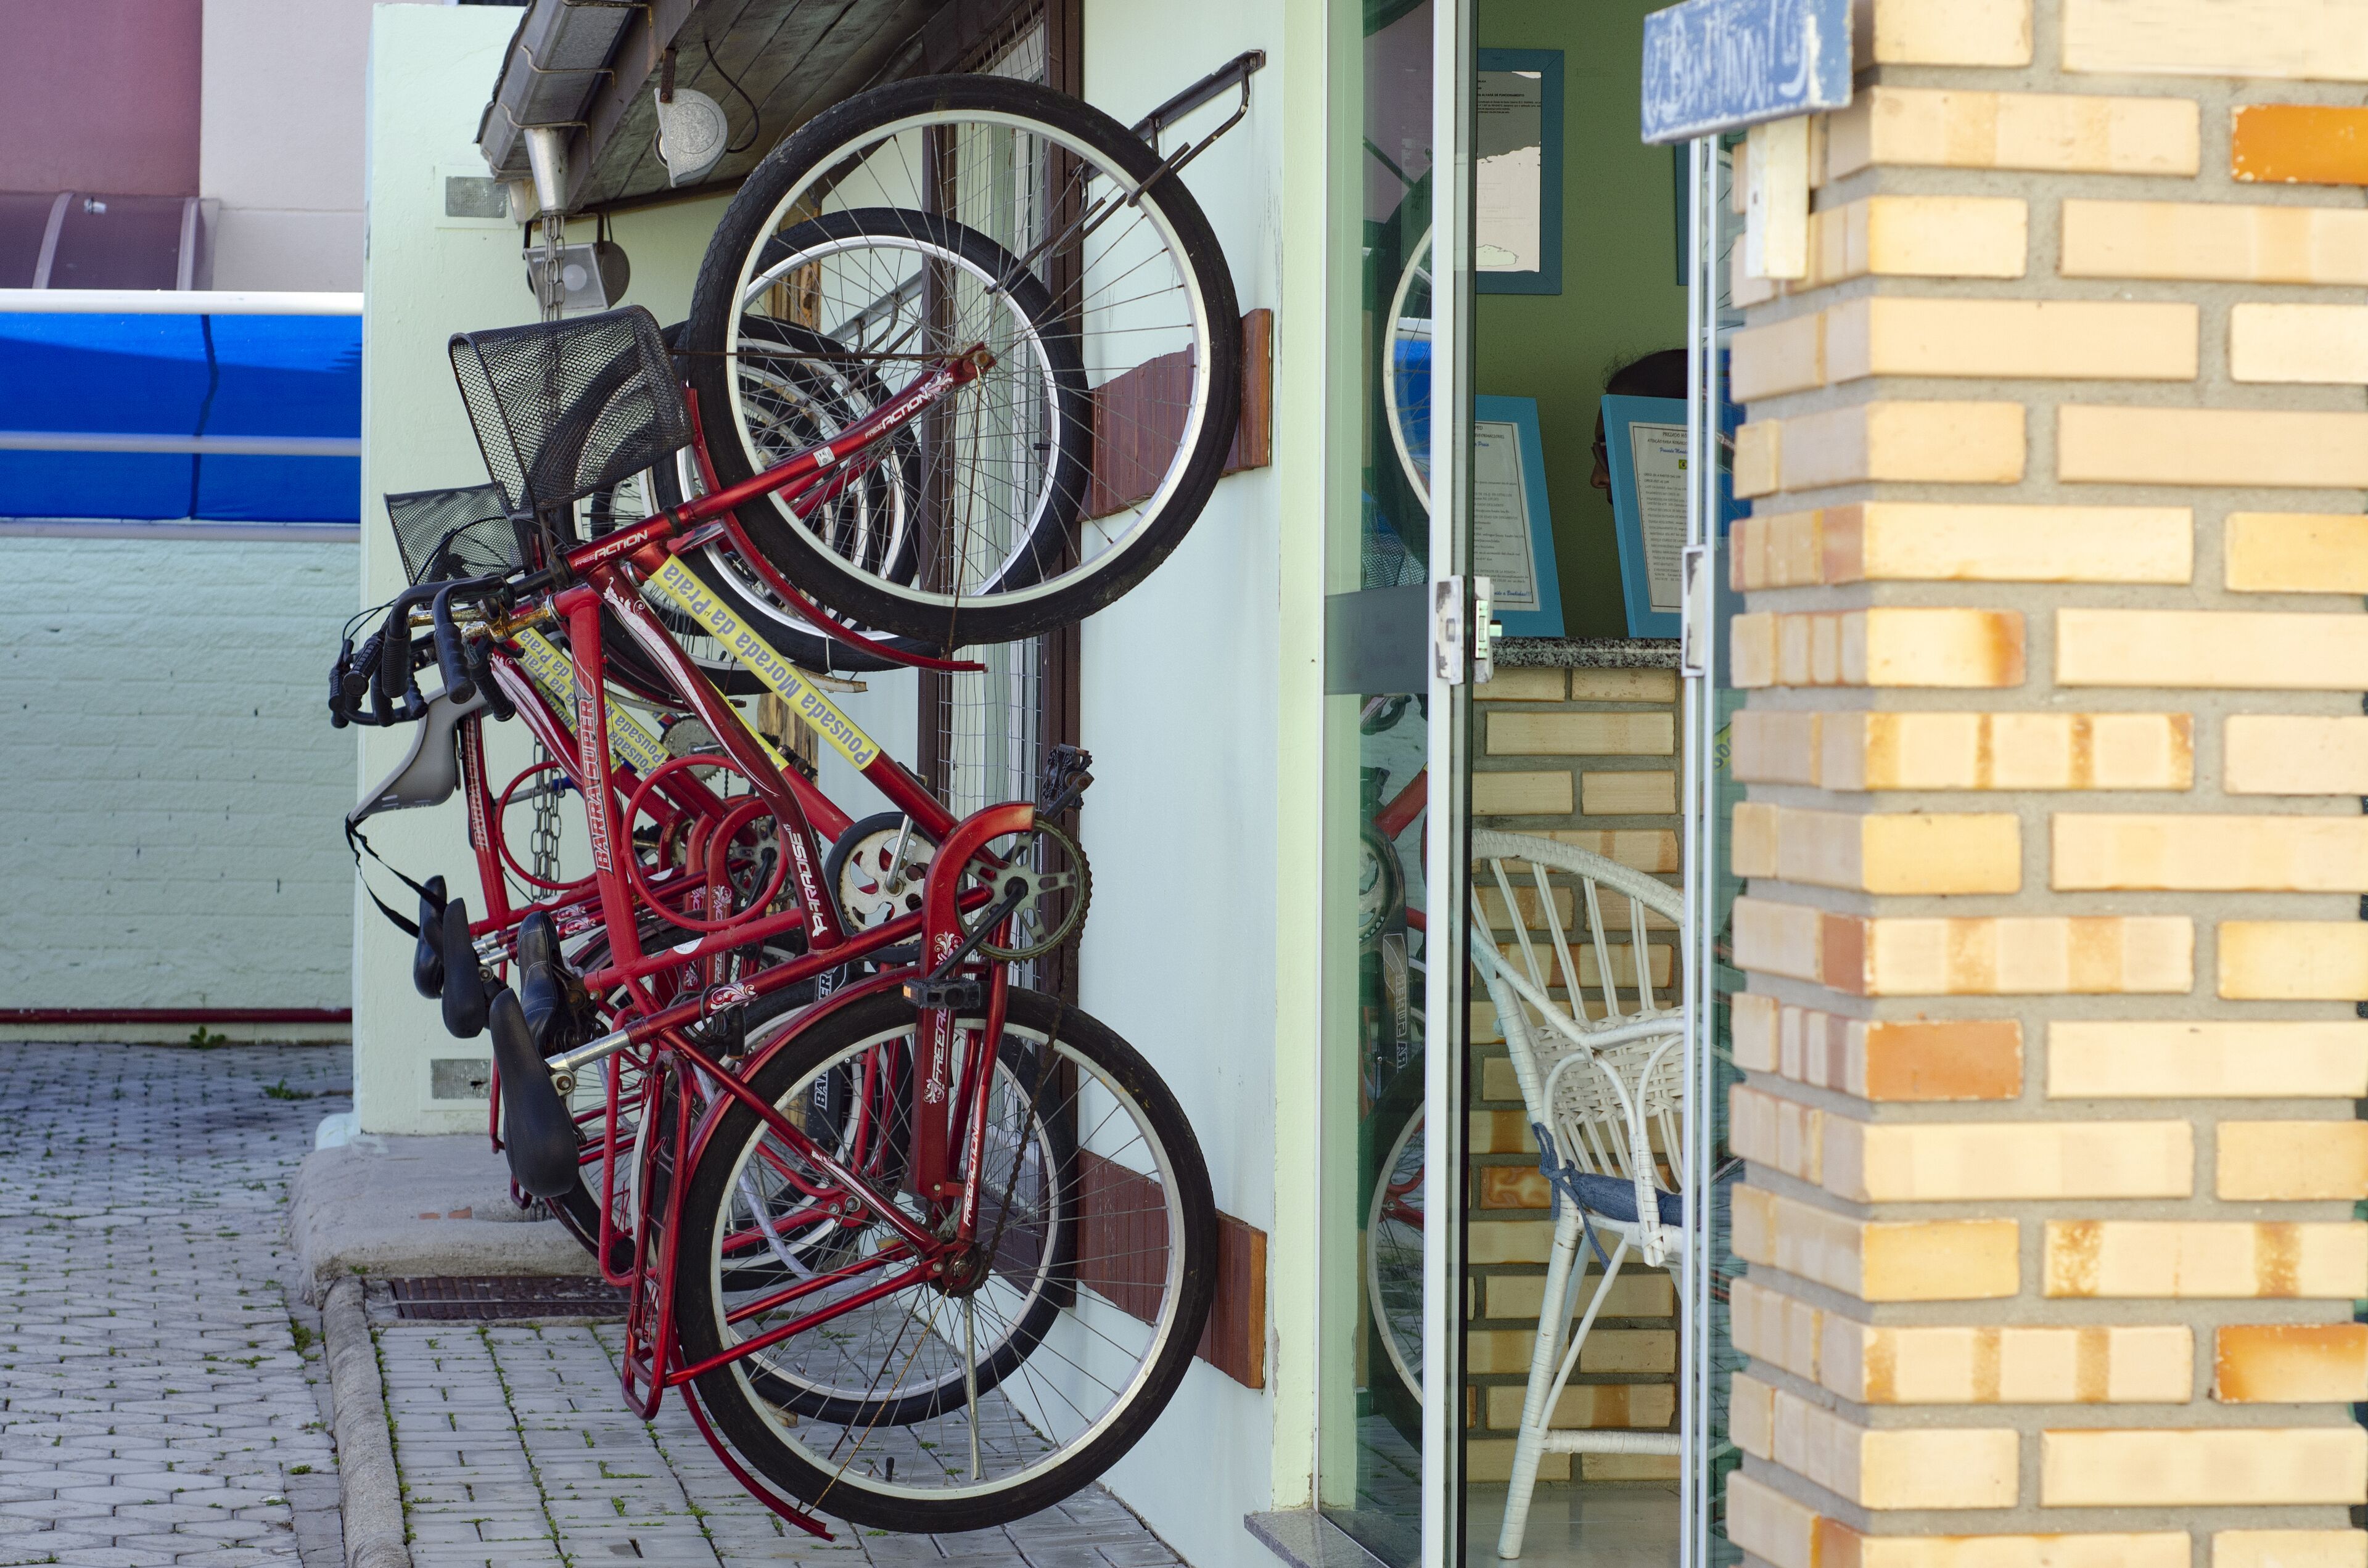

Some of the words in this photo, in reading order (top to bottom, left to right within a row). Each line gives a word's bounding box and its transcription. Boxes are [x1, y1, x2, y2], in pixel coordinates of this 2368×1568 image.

[663, 564, 712, 615] Praia
[520, 630, 553, 664] Praia
[710, 609, 736, 634] da
[553, 660, 570, 677] da
[735, 631, 802, 699] Morada
[580, 699, 601, 781] SUPER
[614, 715, 666, 763] Pousada
[802, 692, 874, 765] Pousada
[586, 784, 614, 874] BARRA
[786, 824, 828, 938] PARADISE
